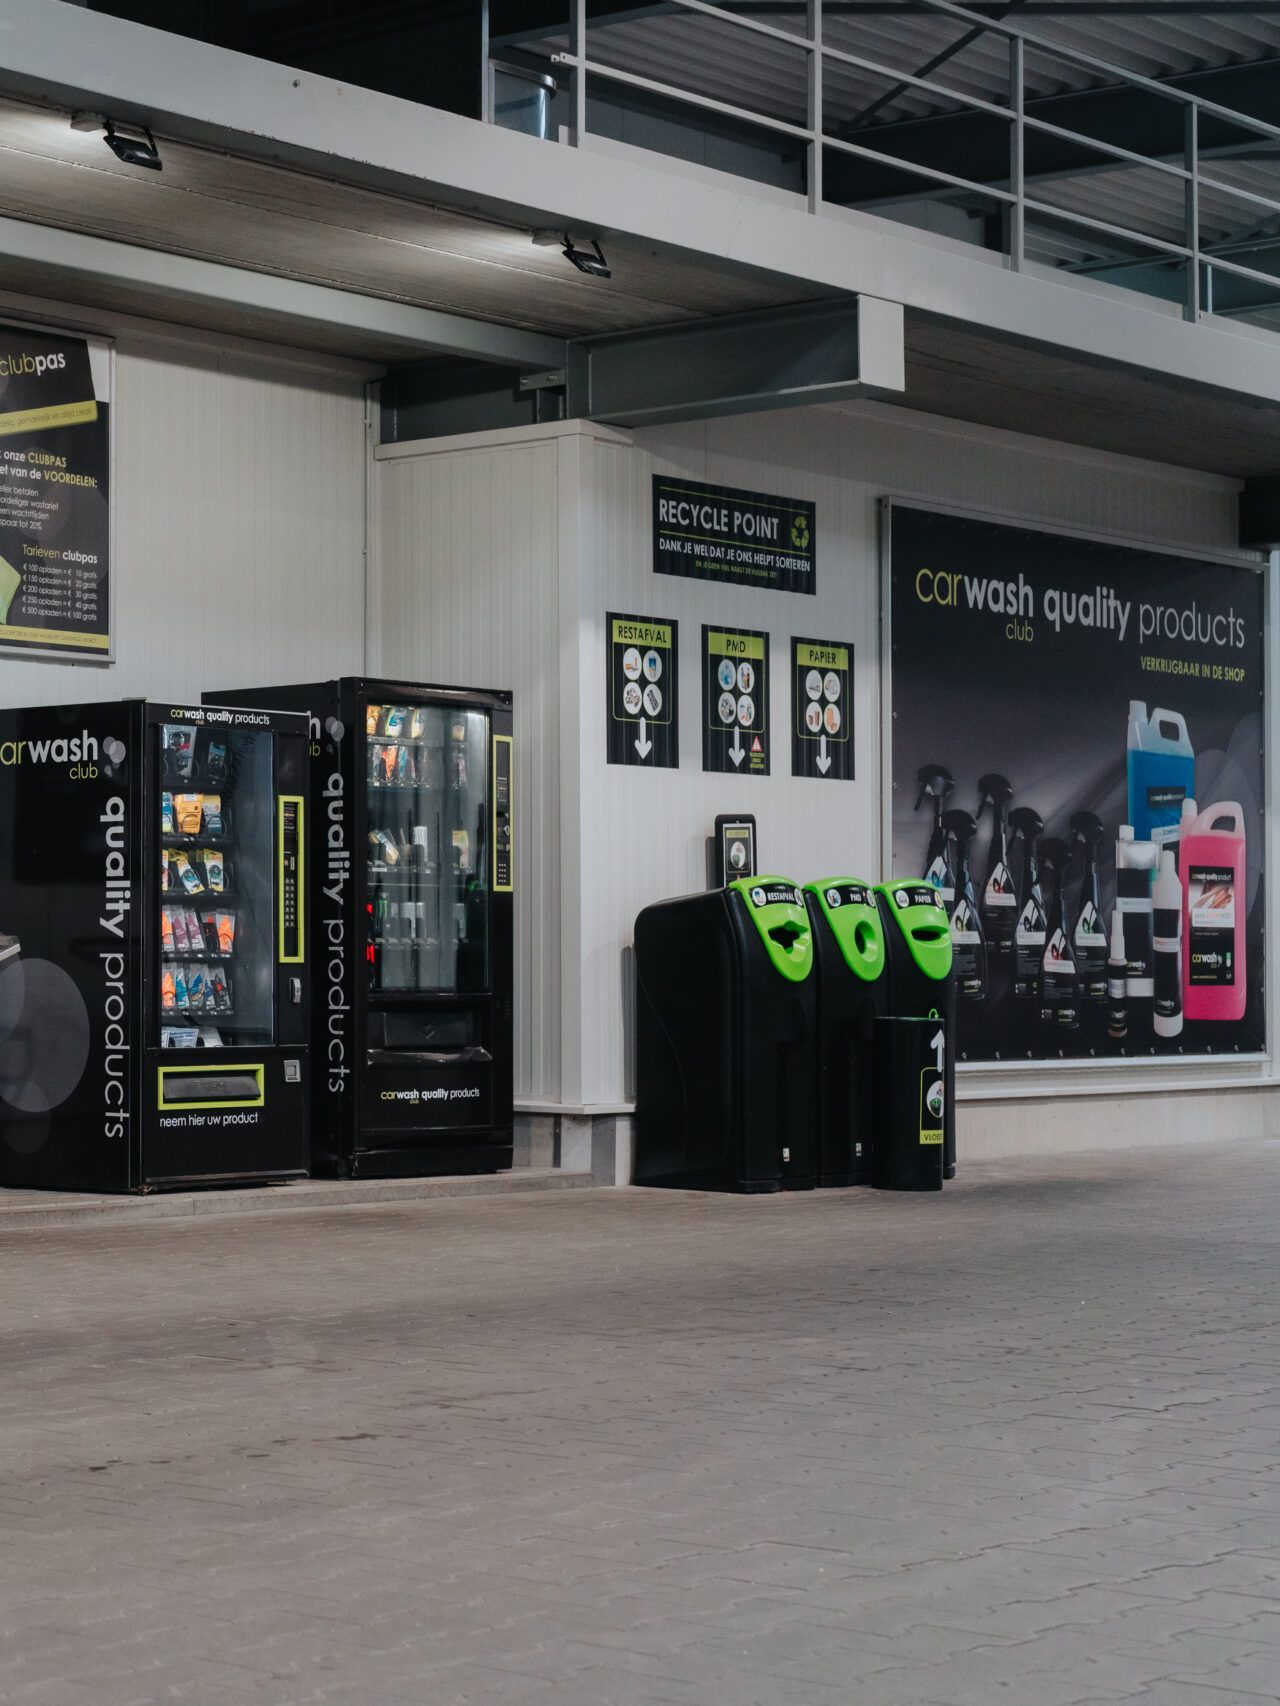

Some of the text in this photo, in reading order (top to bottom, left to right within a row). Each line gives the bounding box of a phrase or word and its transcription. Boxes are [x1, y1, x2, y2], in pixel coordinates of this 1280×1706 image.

[4, 450, 25, 461] onze
[28, 452, 66, 468] CLUBPAS
[10, 468, 28, 478] van
[30, 468, 42, 480] de
[44, 470, 98, 488] VOORDELEN:
[14, 486, 38, 496] betalen
[659, 498, 778, 540] RECYCLE POINT
[22, 544, 98, 564] Tarieven clubpas
[660, 538, 810, 572] DANK JE WEL DAT JE ONS HELPT SORTEREN
[915, 568, 1246, 648] carwash quality products
[618, 625, 667, 644] RESTAFVAL
[1006, 618, 1034, 643] club
[726, 638, 746, 654] PMD
[808, 649, 837, 665] PAPIER
[1140, 656, 1246, 682] VERKRIJGBAAR IN DE SHOP
[170, 709, 270, 725] carwash quality products
[70, 762, 98, 780] club
[322, 772, 350, 906] quality
[100, 796, 131, 938] quality
[767, 892, 794, 901] RESTAFVAL
[850, 893, 862, 902] PMD
[914, 894, 931, 904] PAPIER
[1192, 951, 1218, 964] carwash
[323, 920, 350, 1093] products
[100, 952, 130, 1138] products
[381, 1088, 480, 1101] carwash quality products
[160, 1112, 258, 1127] neem hier uw product
